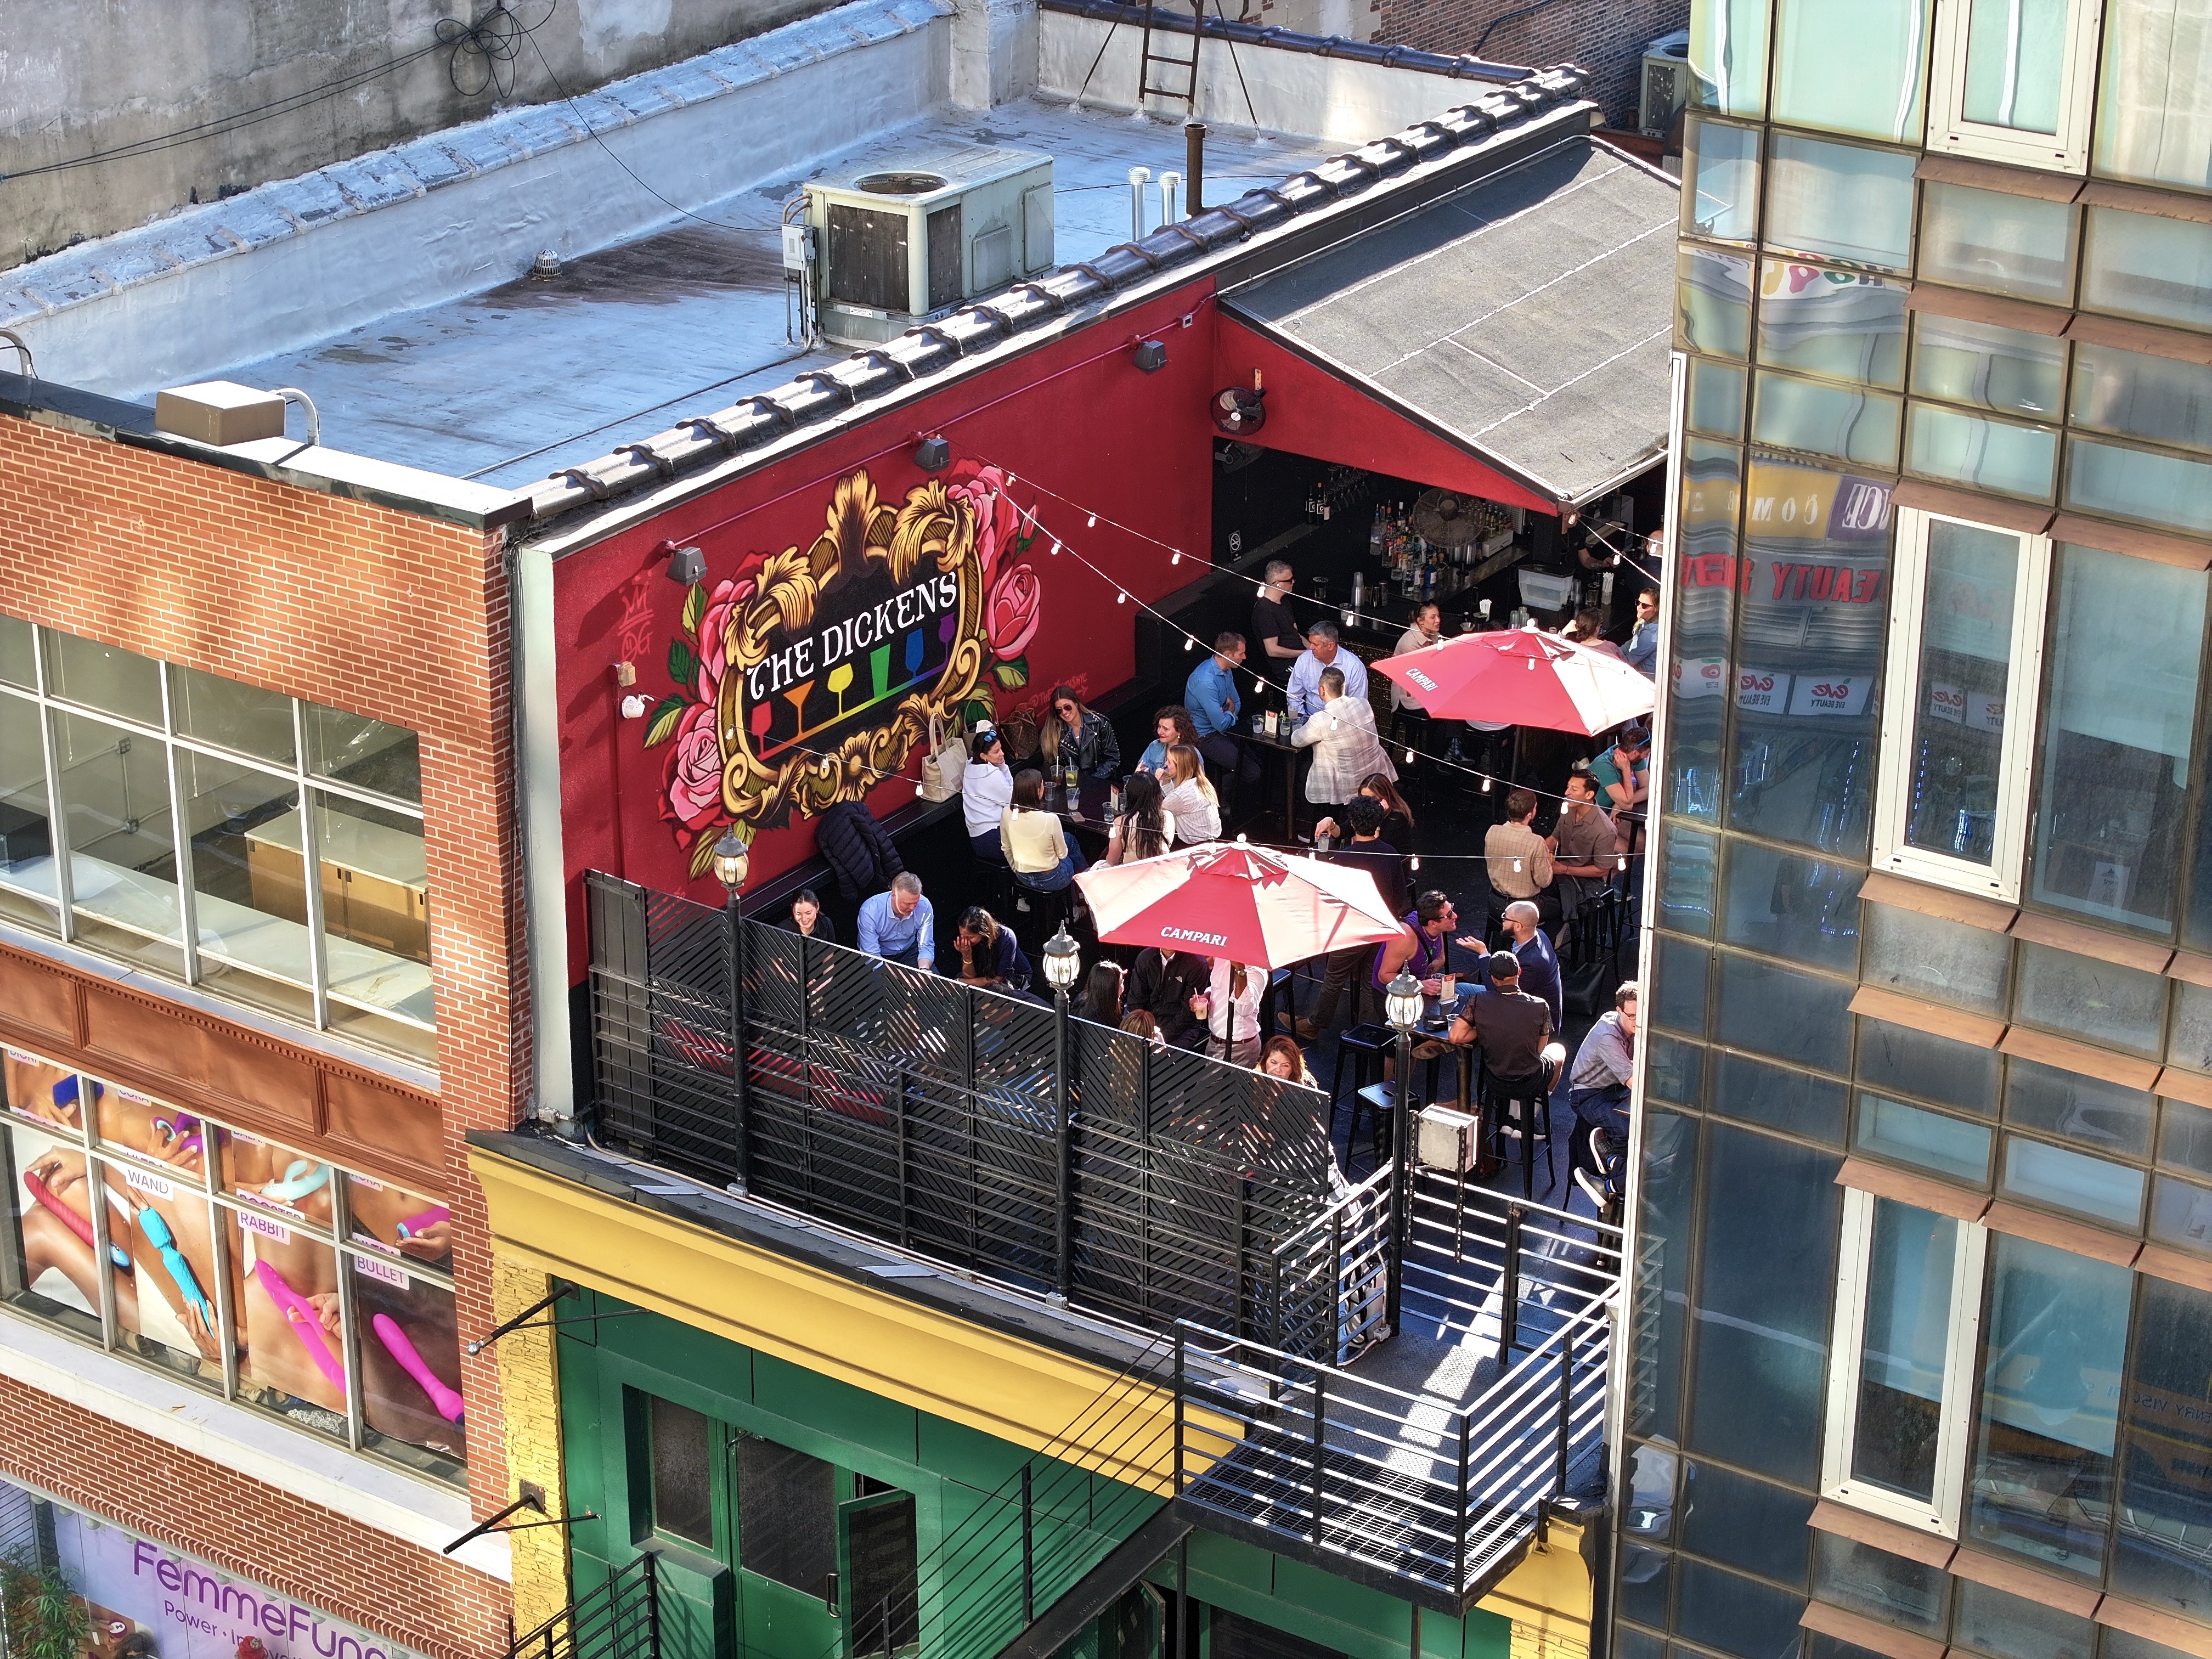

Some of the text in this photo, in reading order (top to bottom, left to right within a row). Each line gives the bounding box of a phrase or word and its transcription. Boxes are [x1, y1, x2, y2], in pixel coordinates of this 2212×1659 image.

[747, 571, 957, 701] THE DICKENS
[1405, 668, 1439, 692] CAMPARI
[1160, 927, 1228, 946] CAMPARI
[128, 1170, 168, 1194] WAND
[240, 1212, 284, 1239] RABBIT
[357, 1256, 405, 1284] BULLET
[164, 1599, 218, 1637] Power
